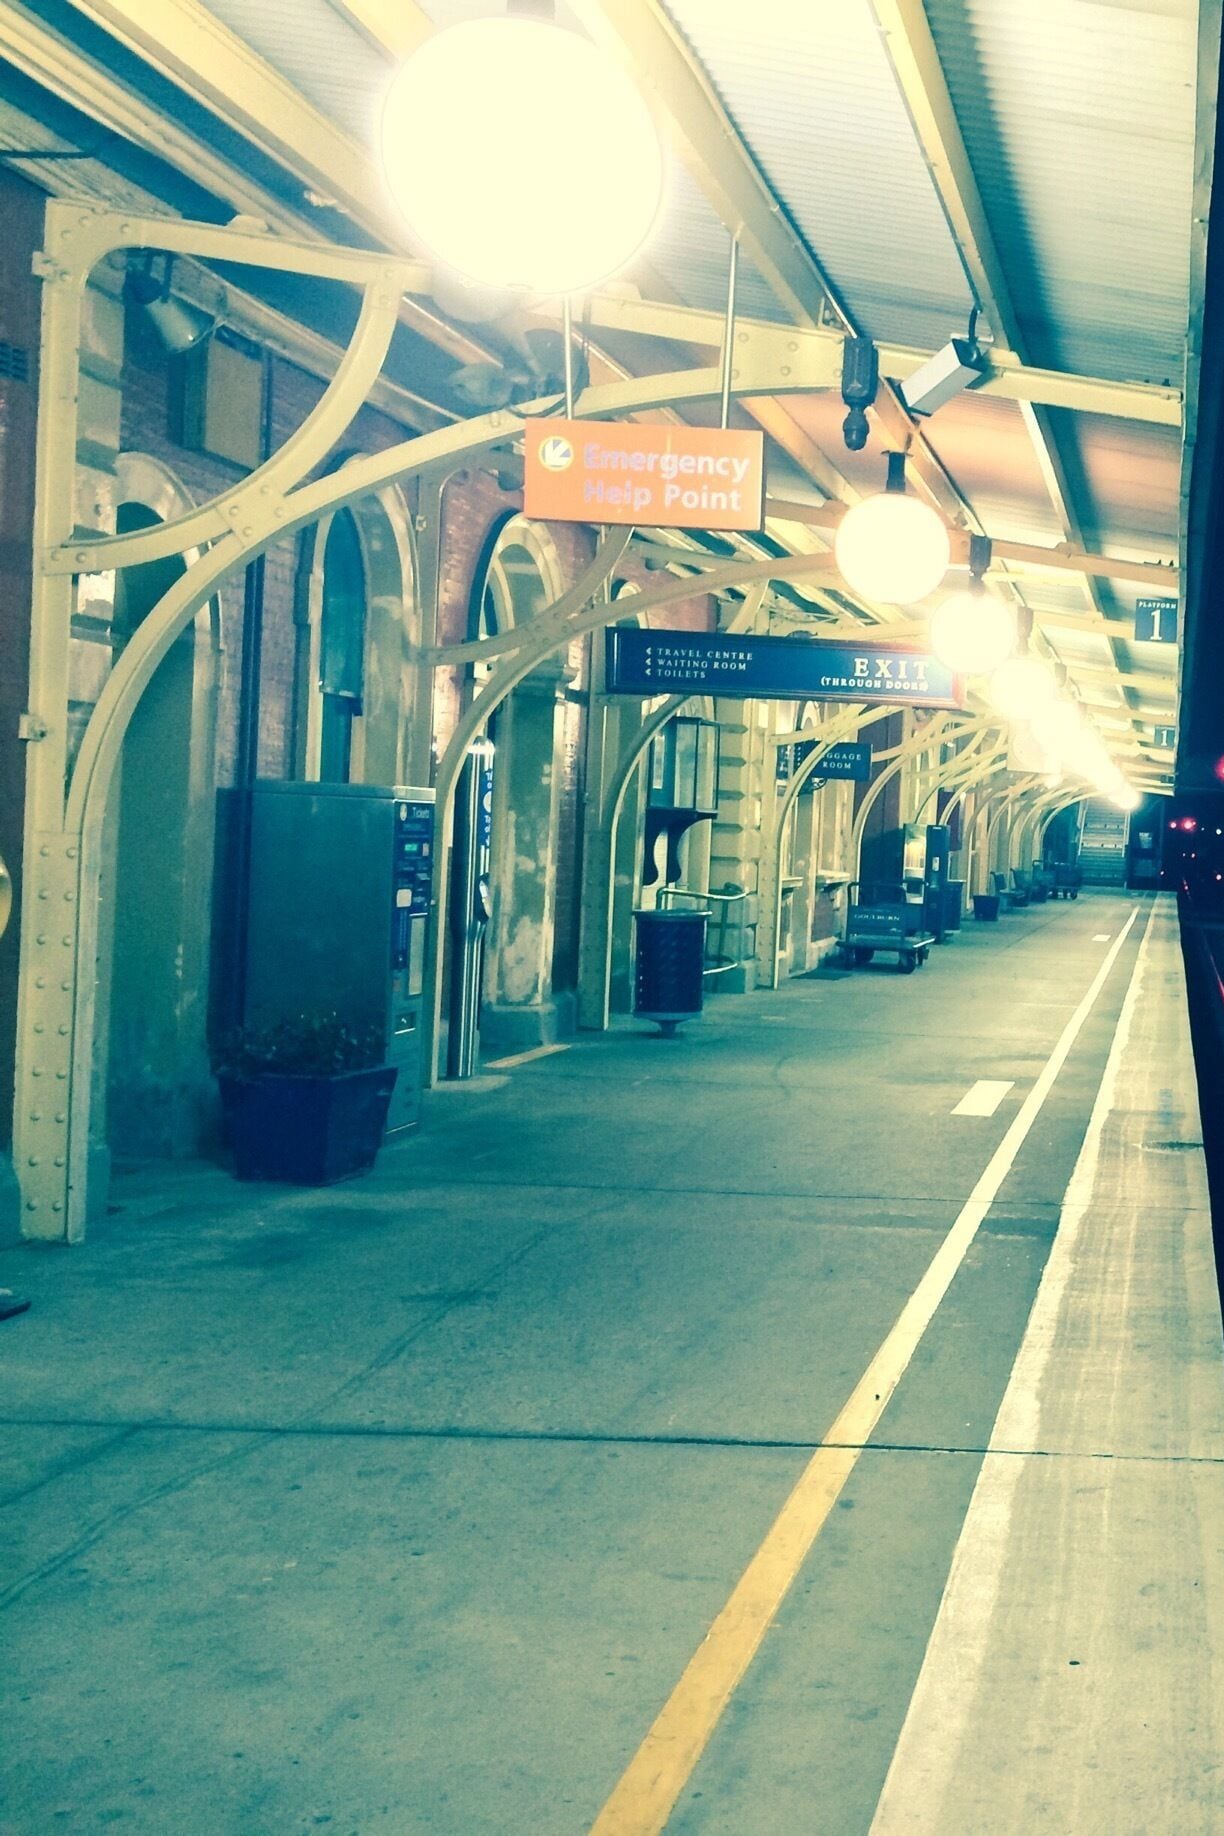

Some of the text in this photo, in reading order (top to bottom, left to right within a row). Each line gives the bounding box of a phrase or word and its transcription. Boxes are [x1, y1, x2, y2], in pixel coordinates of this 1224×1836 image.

[583, 443, 751, 483] Emergency
[583, 479, 742, 511] Help Point
[1138, 600, 1177, 609] PLATFORM
[1150, 609, 1162, 640] 1
[656, 648, 753, 661] TRAVEL CENTRE
[656, 659, 747, 671] WAITING ROOM
[853, 657, 930, 680] EXIT
[657, 668, 706, 679] TOILETS
[820, 676, 882, 689] (THROUGH
[1160, 730, 1168, 747] 1
[822, 752, 862, 761] GGAGE
[822, 761, 852, 769] ROOM
